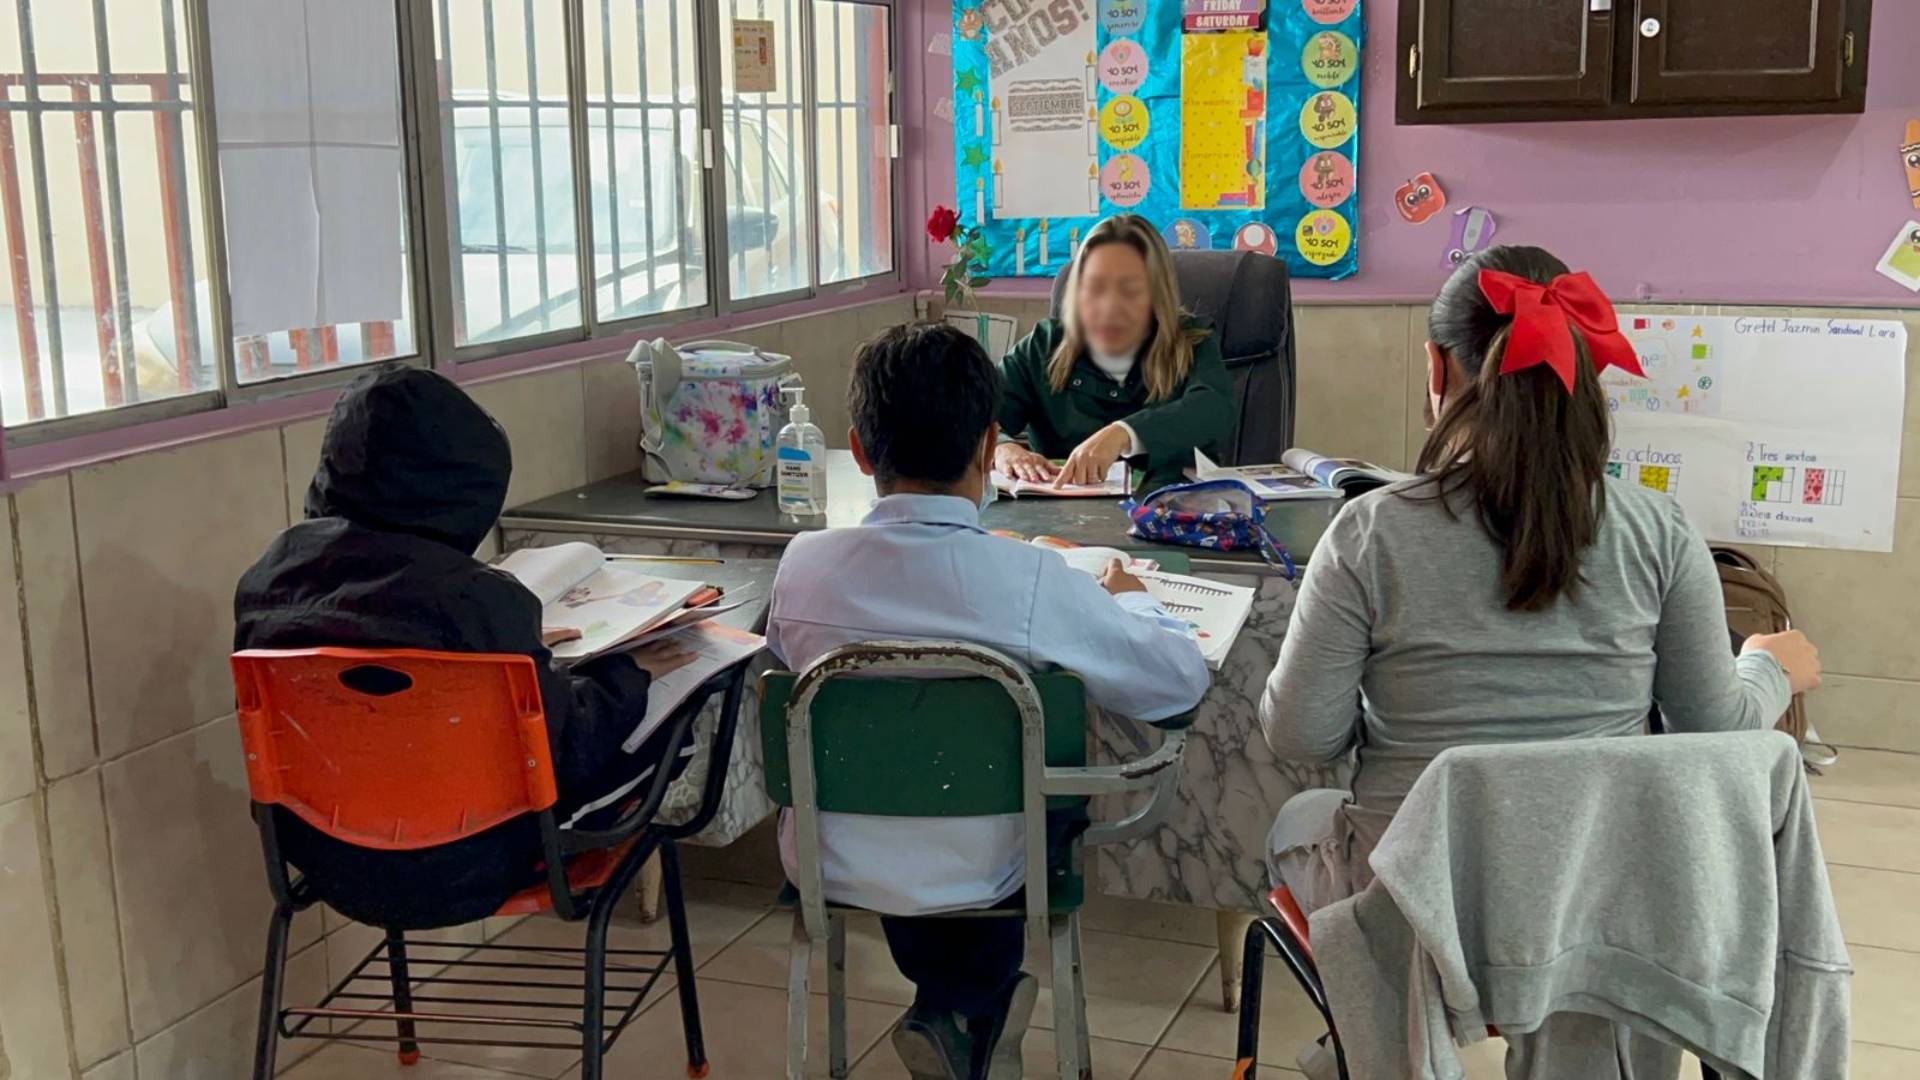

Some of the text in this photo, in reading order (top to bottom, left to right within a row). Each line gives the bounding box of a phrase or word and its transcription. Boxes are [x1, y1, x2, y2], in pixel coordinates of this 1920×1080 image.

[1203, 0, 1242, 11] FRIDAY
[1107, 8, 1139, 18] YO SOY
[1195, 14, 1250, 27] SATURDAY
[1312, 59, 1346, 68] YO SOY
[1107, 65, 1139, 76] YO SOY
[1108, 122, 1140, 133] YO SOY
[1312, 118, 1346, 132] YO SOY
[1110, 181, 1141, 190] YO SOY
[1310, 177, 1345, 190] YO SOY
[1305, 238, 1340, 249] YO SOY
[1869, 324, 1897, 339] Lara
